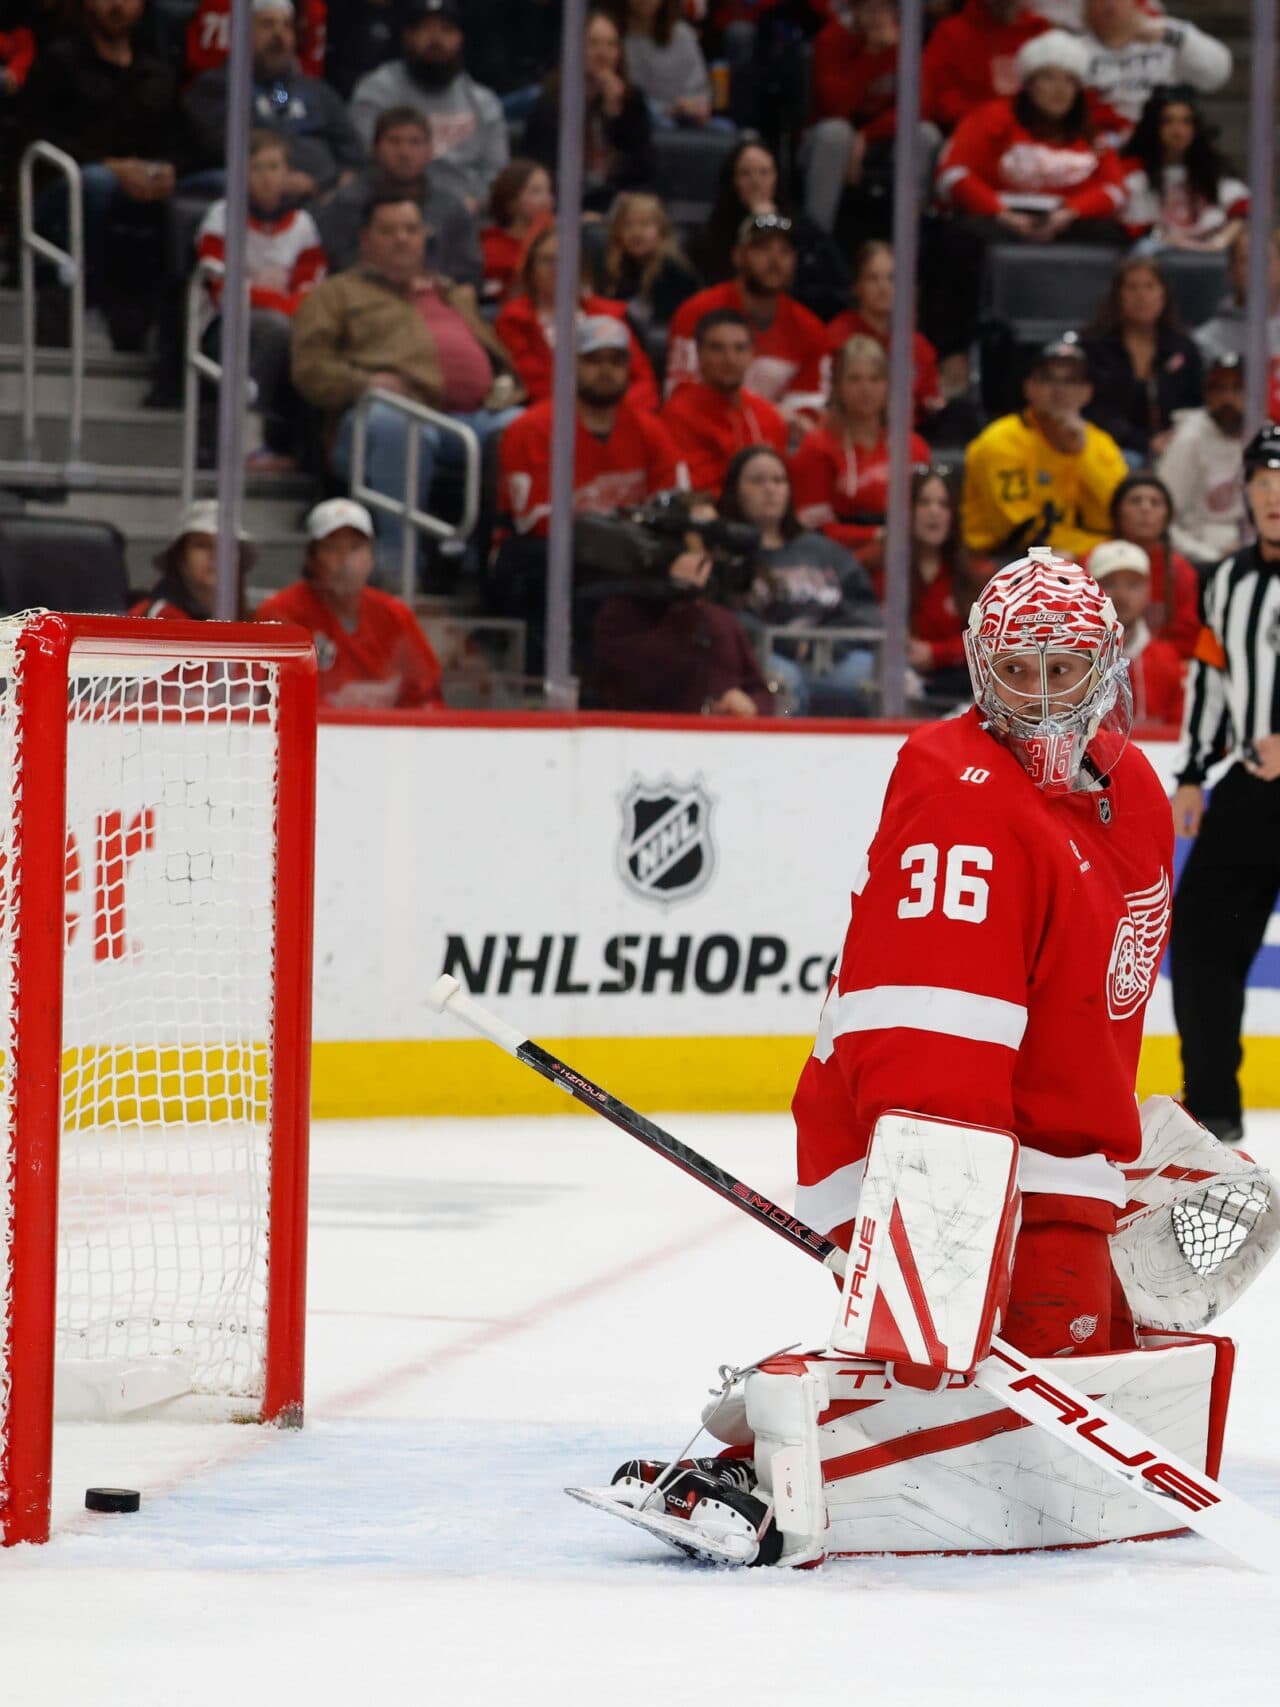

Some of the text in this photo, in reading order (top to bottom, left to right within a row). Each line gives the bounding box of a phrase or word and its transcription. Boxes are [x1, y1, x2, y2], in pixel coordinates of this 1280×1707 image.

[958, 766, 991, 785] 10
[1024, 731, 1075, 784] 36
[636, 808, 699, 882] NHL
[897, 842, 994, 925] 36
[730, 1182, 827, 1250] SMOKE
[843, 1215, 877, 1329] TRUE
